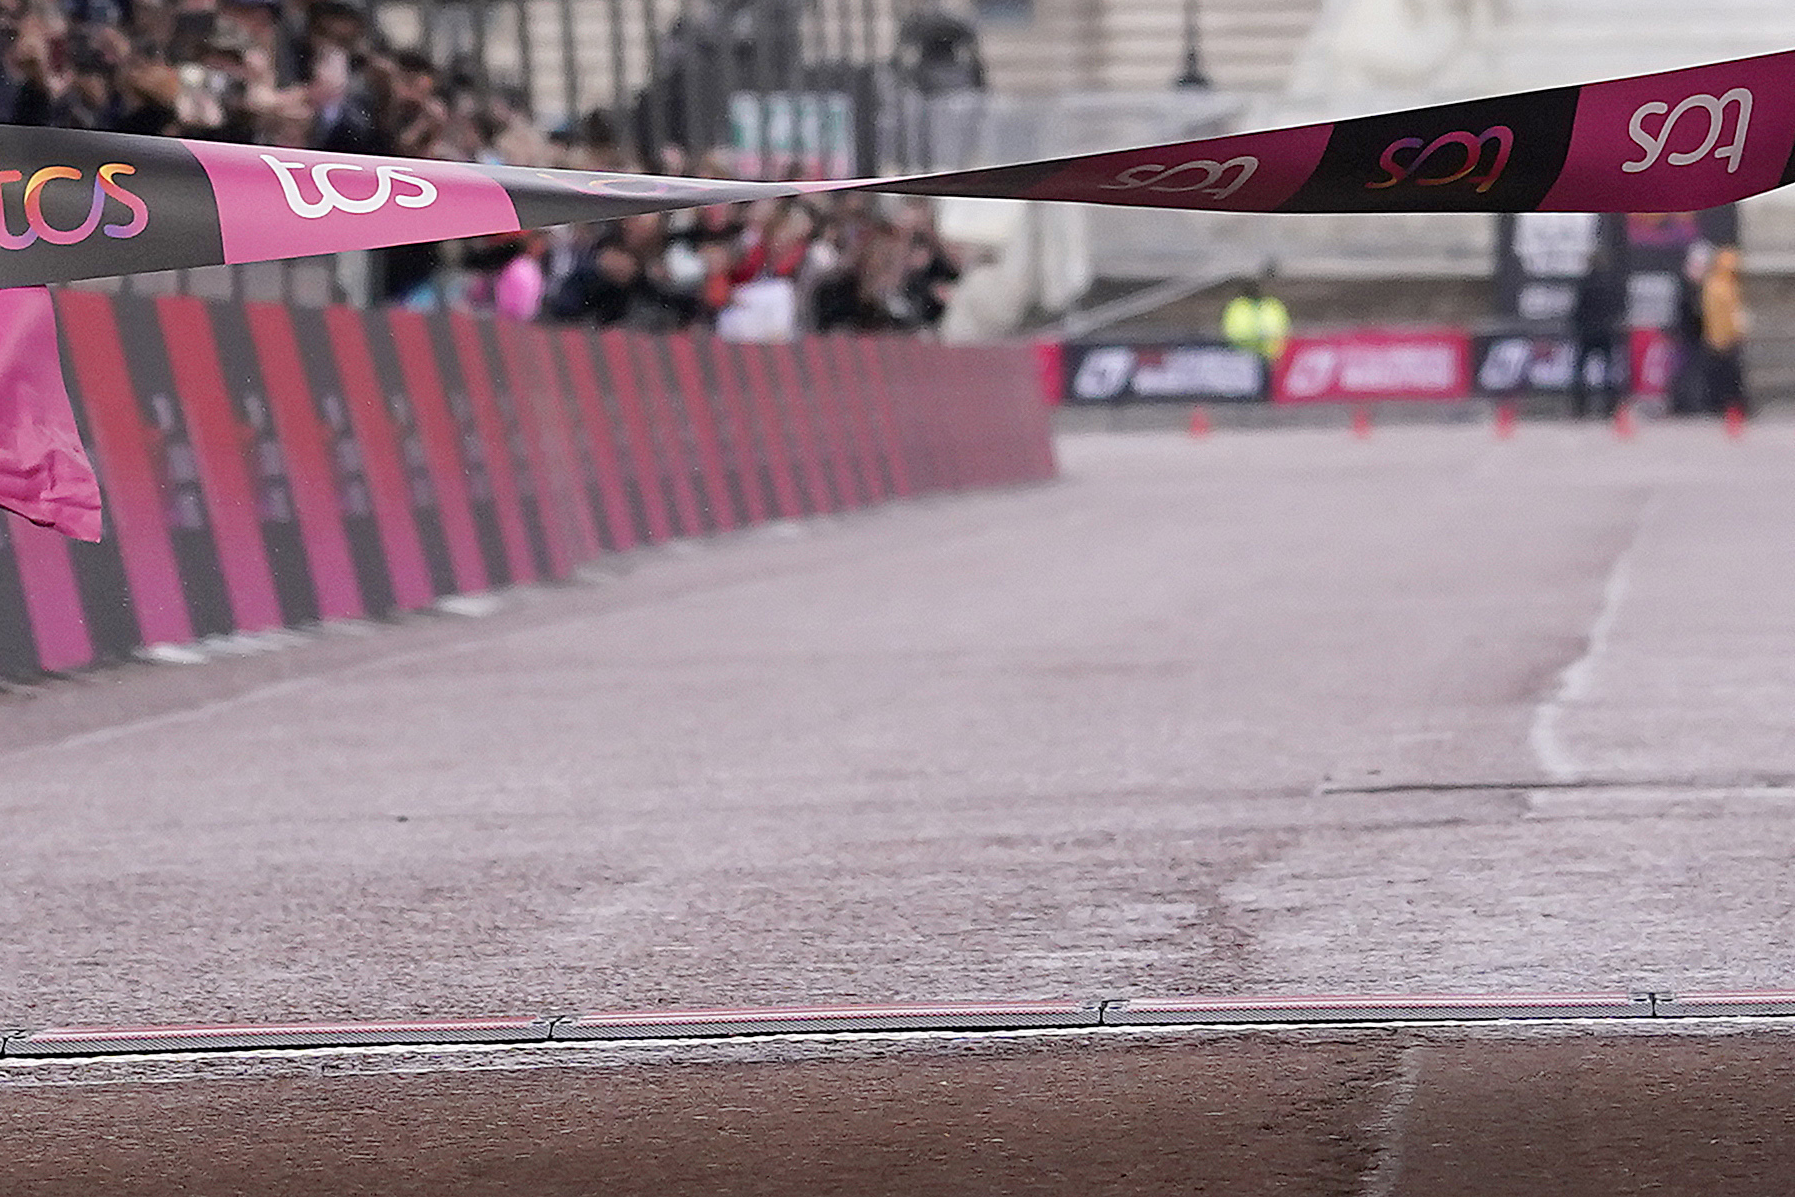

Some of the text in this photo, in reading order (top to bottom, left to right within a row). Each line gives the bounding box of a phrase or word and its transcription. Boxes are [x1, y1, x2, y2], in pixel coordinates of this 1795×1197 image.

[1365, 125, 1515, 193] tcs
[1621, 87, 1754, 174] tcs
[260, 153, 438, 219] tcs
